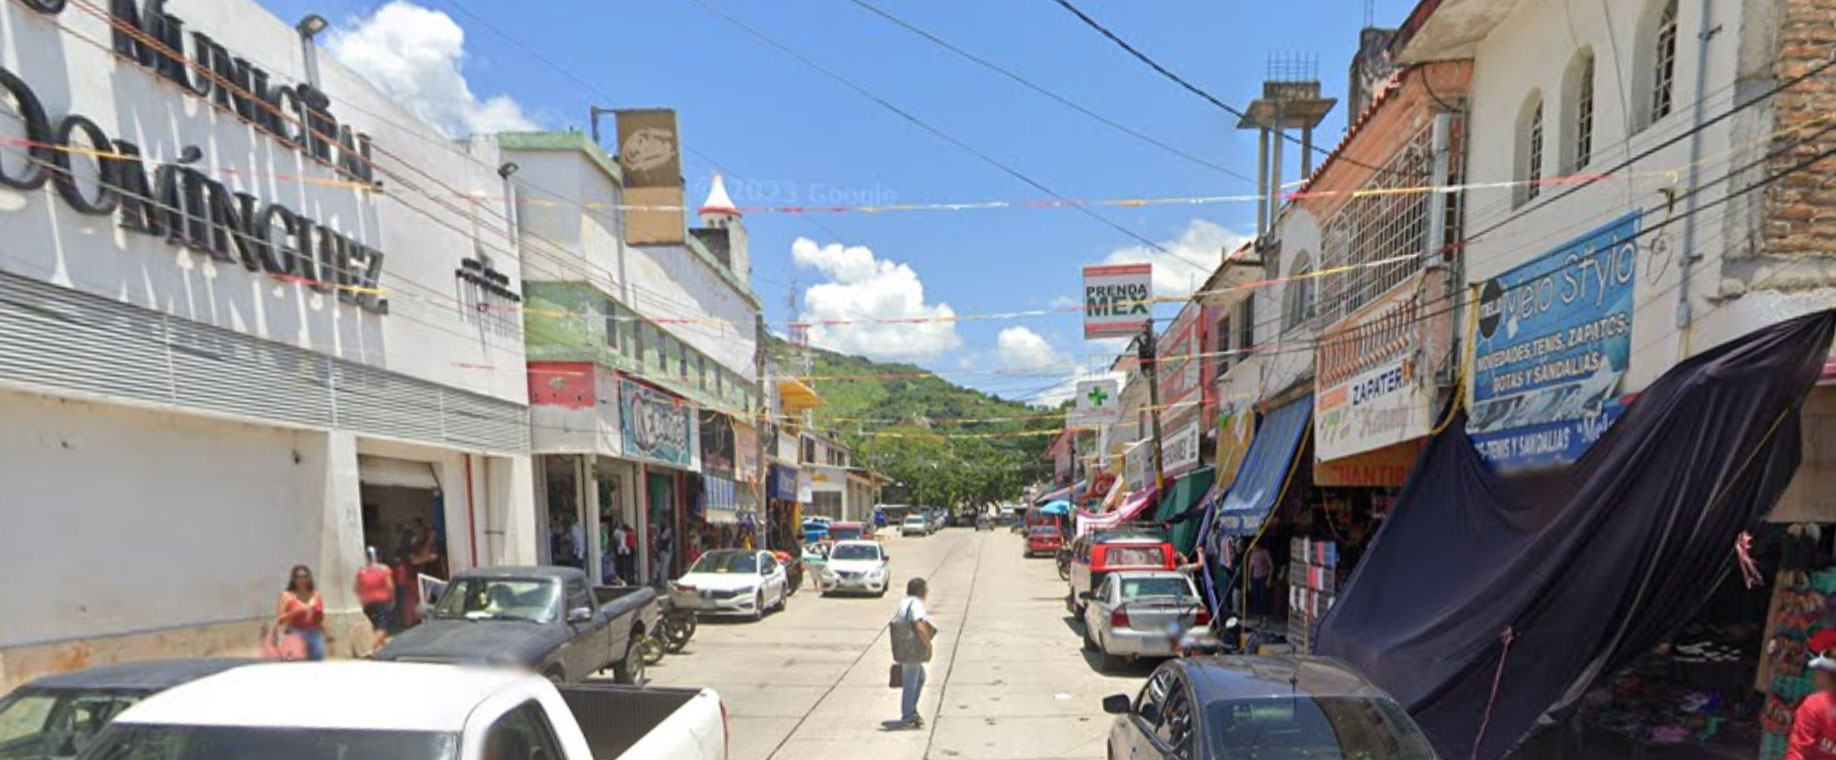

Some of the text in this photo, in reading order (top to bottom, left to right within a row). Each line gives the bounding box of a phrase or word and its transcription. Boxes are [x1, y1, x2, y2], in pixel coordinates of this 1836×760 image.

[1086, 283, 1147, 297] PRENDA
[1086, 294, 1148, 317] MEX
[1493, 372, 1524, 393] BOTAS
[1525, 369, 1534, 385] Y
